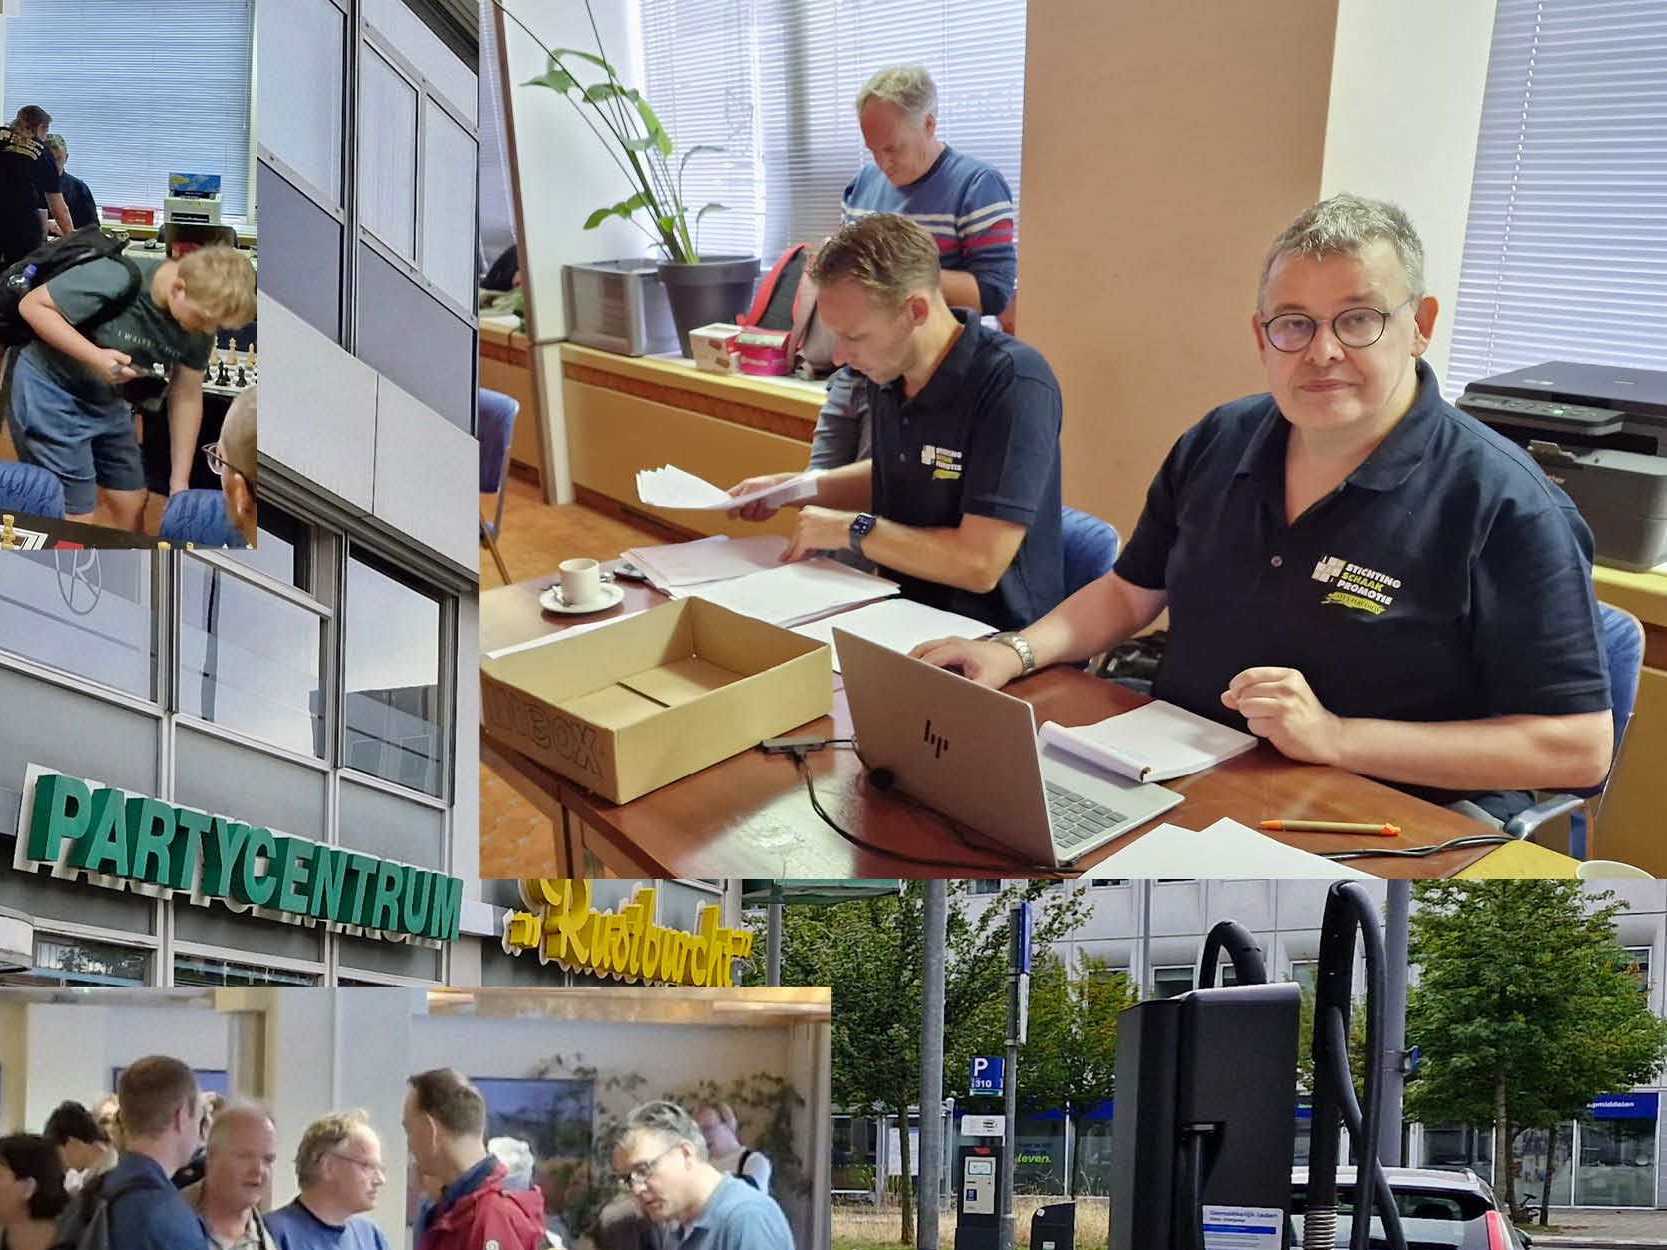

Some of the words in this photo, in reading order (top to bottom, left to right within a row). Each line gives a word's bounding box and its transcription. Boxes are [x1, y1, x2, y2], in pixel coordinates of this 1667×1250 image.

[1341, 571, 1385, 592] SCHAAK
[1345, 563, 1402, 589] STICHTING
[1336, 579, 1393, 605] PROMOTIE
[27, 774, 464, 941] PARTYCENTRUM
[973, 1057, 989, 1077] P
[1017, 1153, 1052, 1164] leven.
